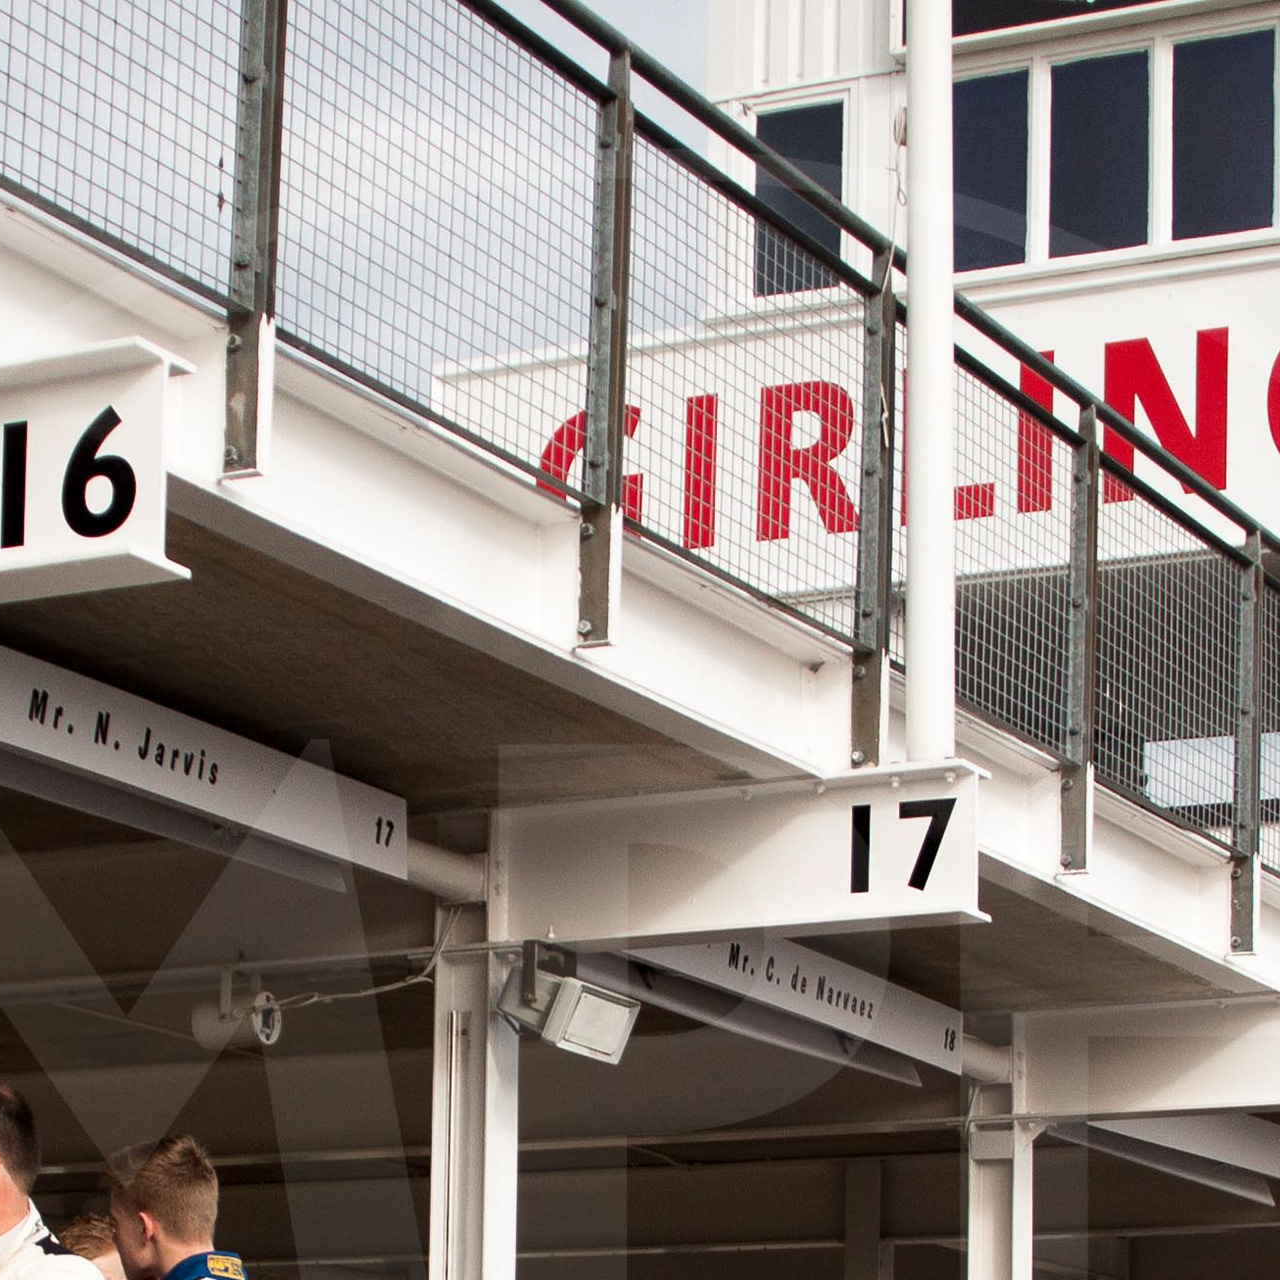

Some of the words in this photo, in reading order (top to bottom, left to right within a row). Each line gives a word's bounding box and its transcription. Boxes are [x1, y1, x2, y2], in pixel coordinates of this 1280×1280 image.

[0, 404, 138, 550] 16
[29, 688, 72, 737] Mr.
[95, 711, 121, 751] N.
[139, 728, 219, 785] Jarvis
[375, 816, 395, 848] 17
[849, 796, 959, 894] 17
[728, 943, 754, 976] Mr.
[765, 957, 781, 986] C.
[791, 964, 808, 994] de
[816, 976, 874, 1019] Narvaez
[944, 1027, 956, 1051] 18
